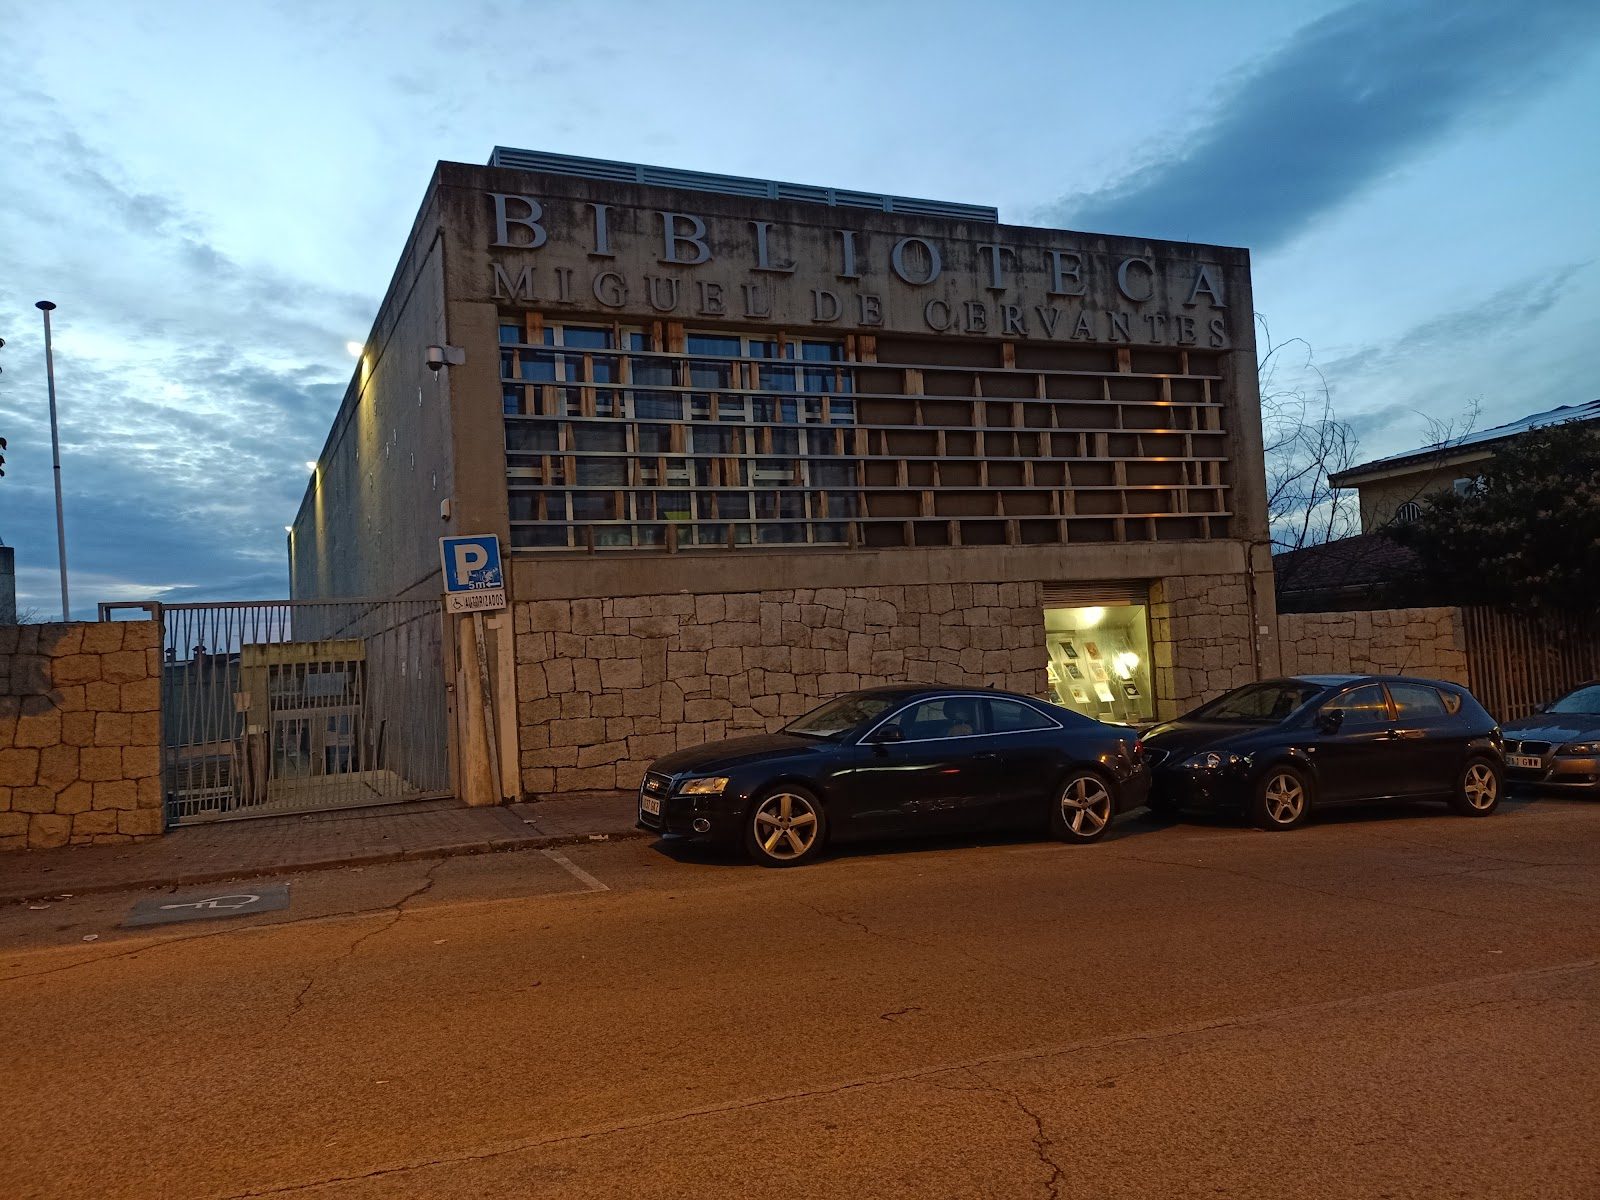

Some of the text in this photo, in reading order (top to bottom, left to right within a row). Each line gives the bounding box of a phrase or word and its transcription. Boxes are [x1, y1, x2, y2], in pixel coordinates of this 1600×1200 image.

[486, 191, 1228, 309] BIBLIOTECA
[489, 262, 1227, 349] MIGUEL DE CERVANTES
[454, 543, 488, 585] P
[465, 594, 504, 608] AUTORIZADOS
[468, 581, 486, 590] 5m
